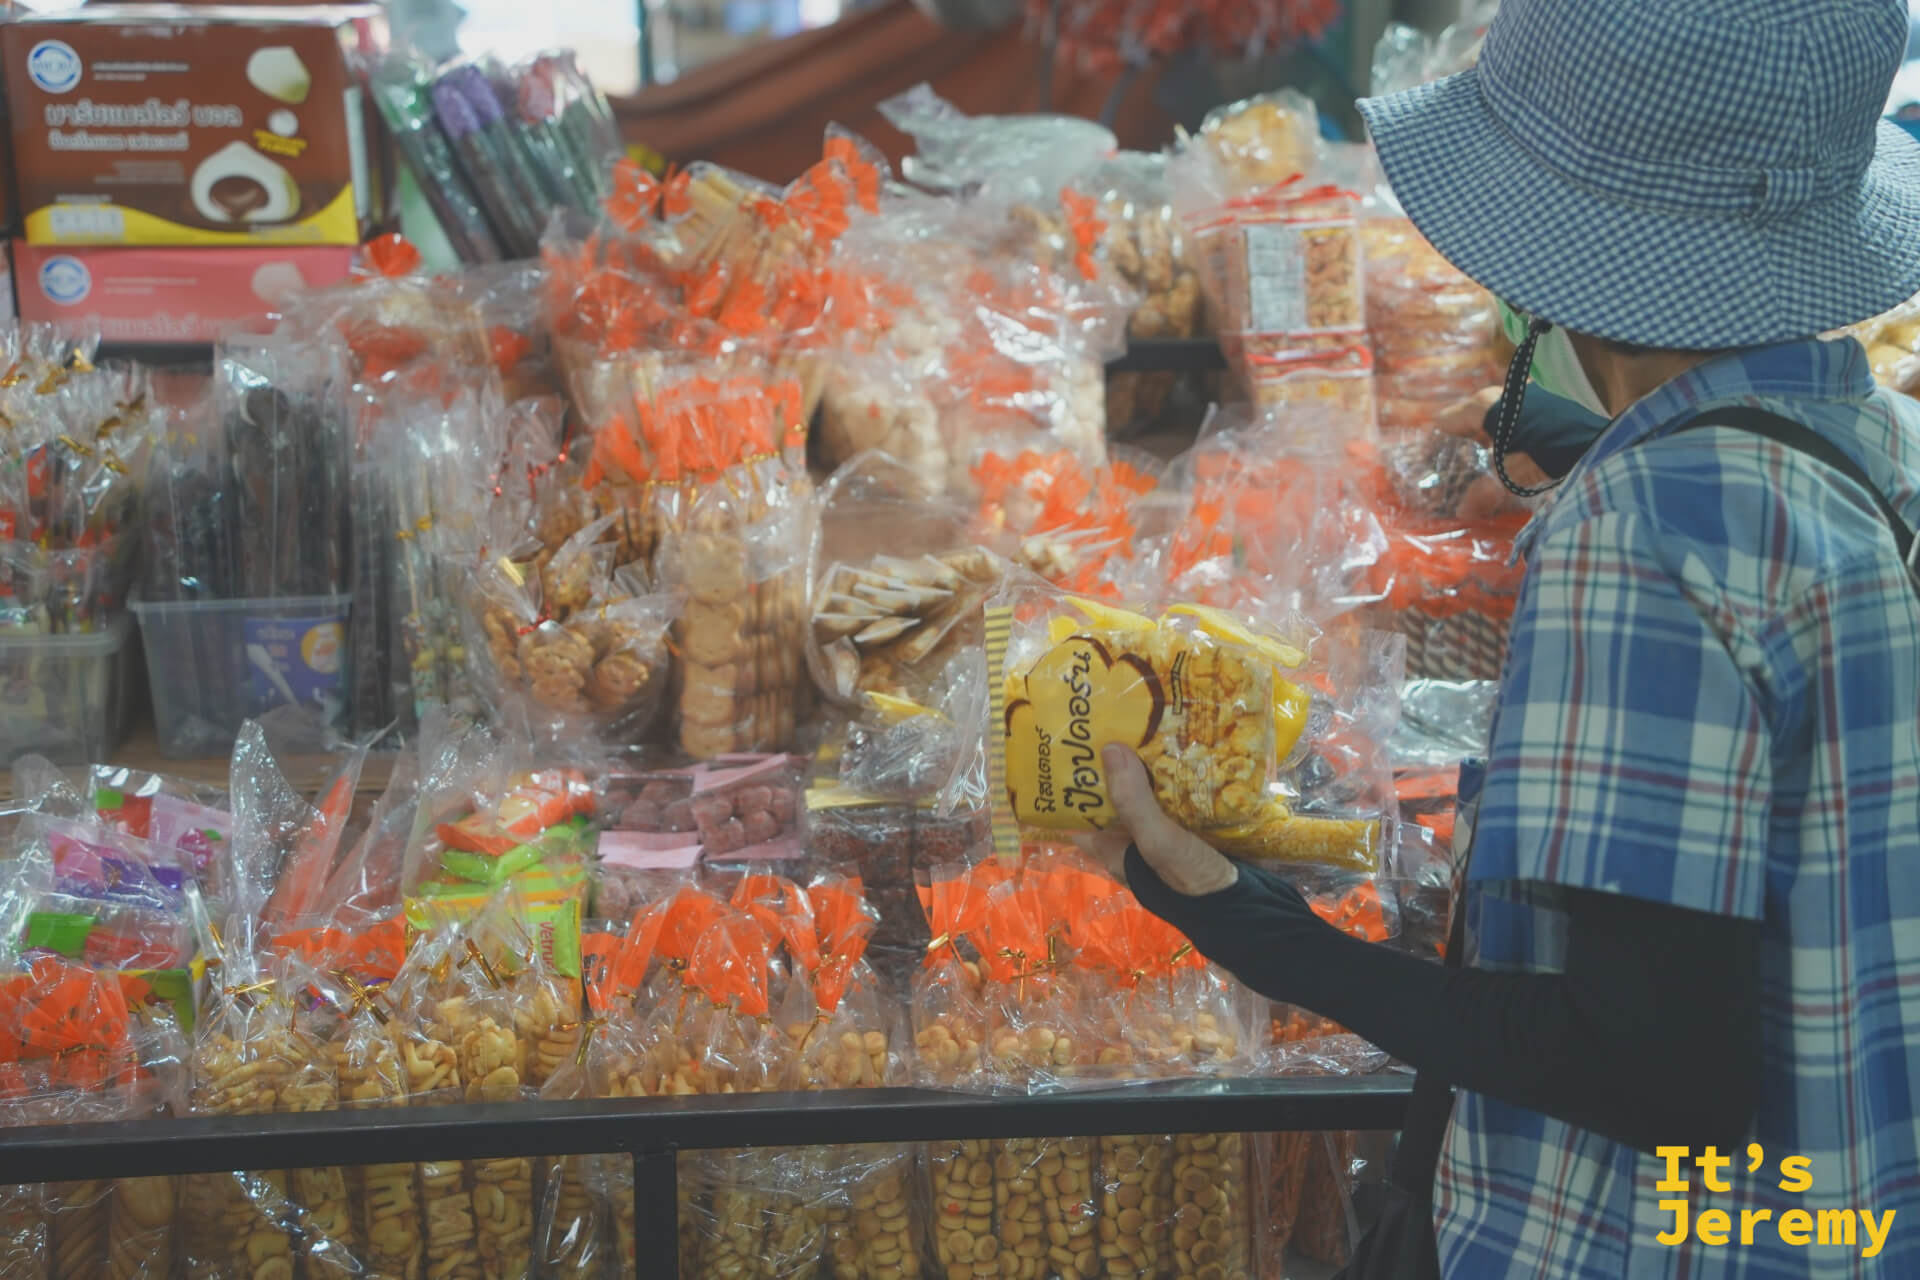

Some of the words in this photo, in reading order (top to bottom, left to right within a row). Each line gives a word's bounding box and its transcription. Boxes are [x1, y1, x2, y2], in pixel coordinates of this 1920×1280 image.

[1034, 725, 1056, 813] มิสเตอร์
[1061, 651, 1104, 813] ป๊อปคอร์น
